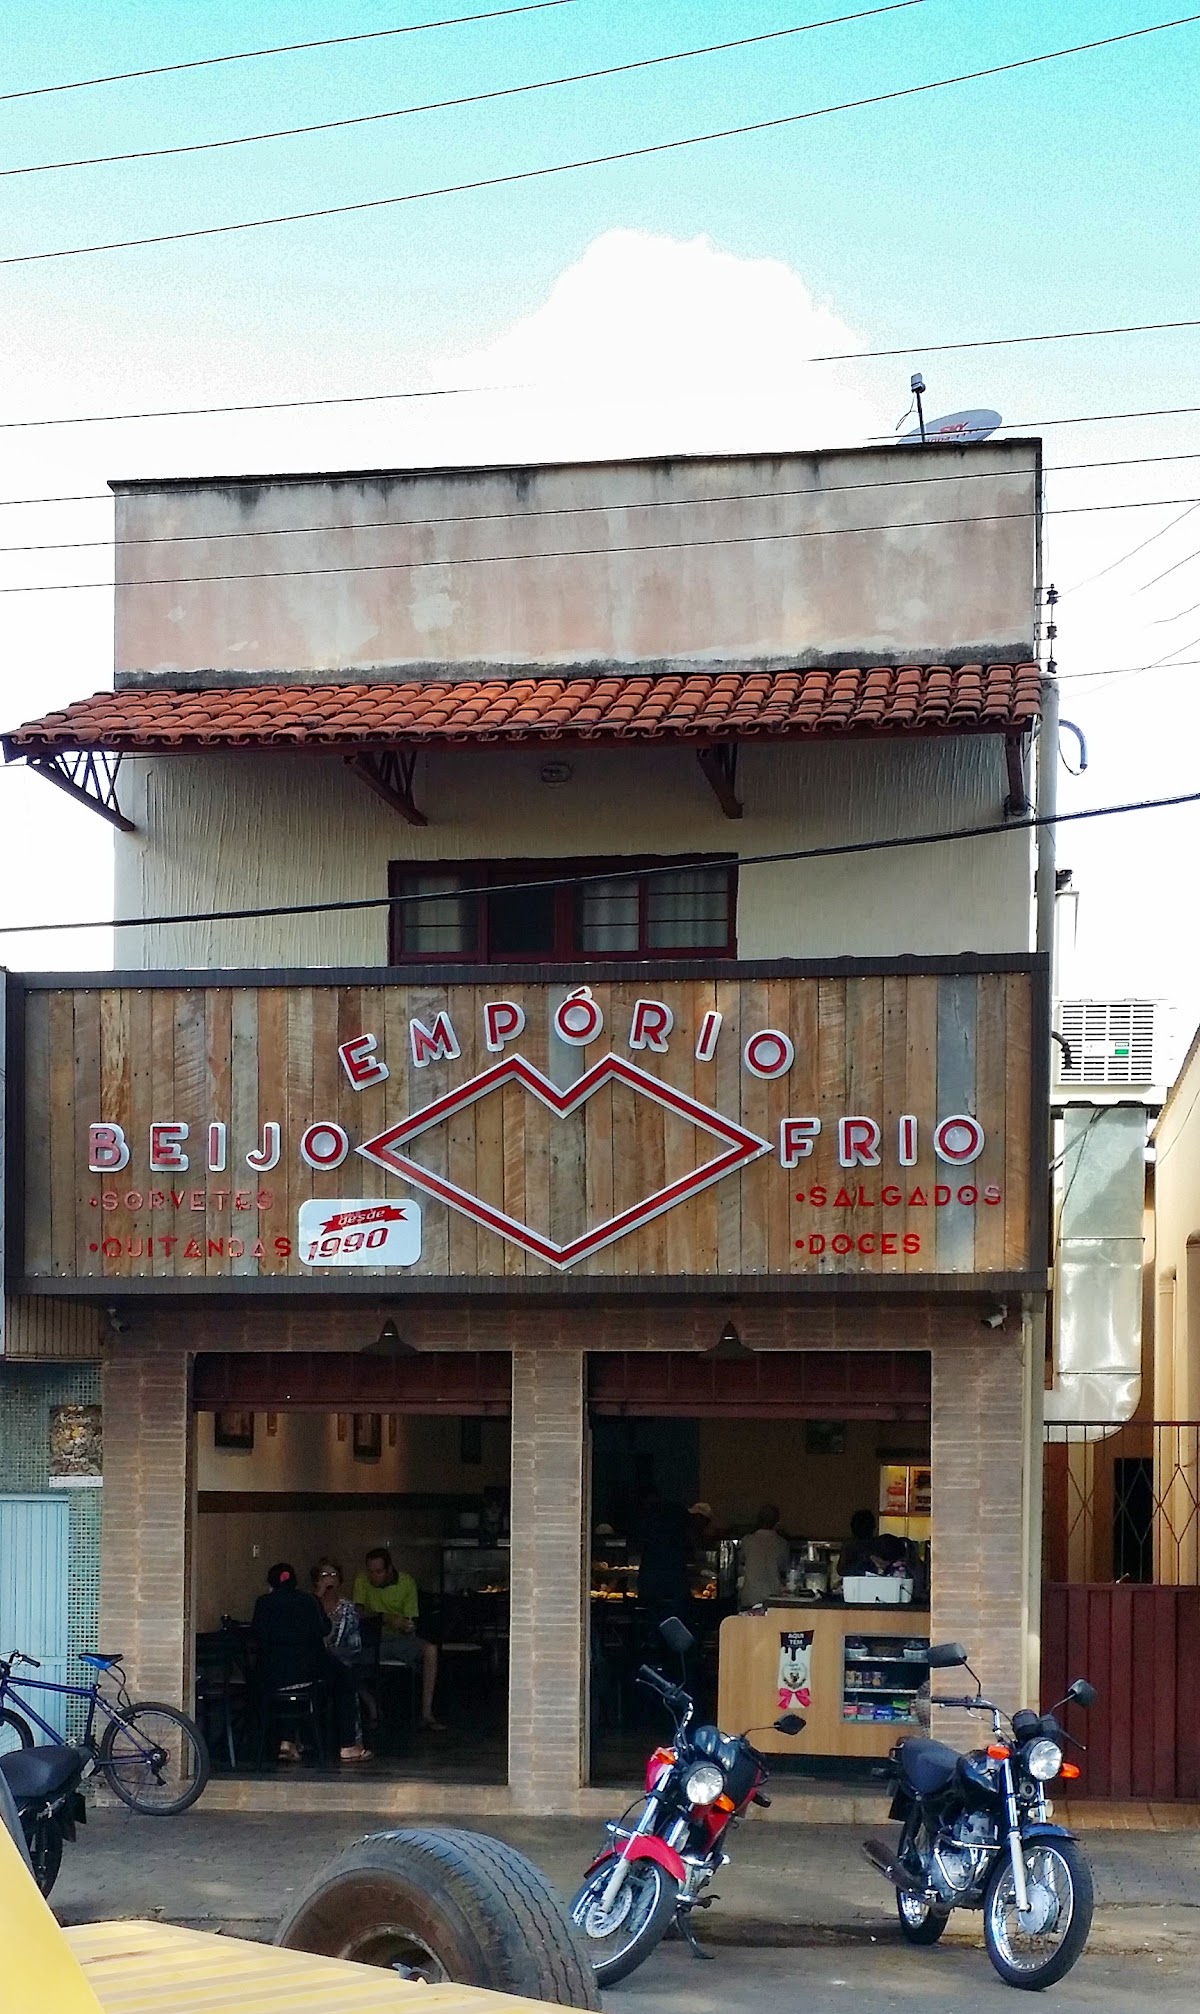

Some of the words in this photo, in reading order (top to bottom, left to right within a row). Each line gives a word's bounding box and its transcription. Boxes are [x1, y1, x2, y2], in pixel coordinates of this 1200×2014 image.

[338, 985, 795, 1092] EMPÓRIO
[88, 1122, 349, 1173] BEIJO
[780, 1114, 985, 1169] FRIO
[101, 1190, 273, 1211] SORVETES
[808, 1185, 1002, 1208] SALGADOS
[337, 1209, 386, 1226] desde
[101, 1236, 292, 1258] QUITANDAS
[307, 1227, 389, 1261] 1990
[808, 1232, 921, 1255] DOCES
